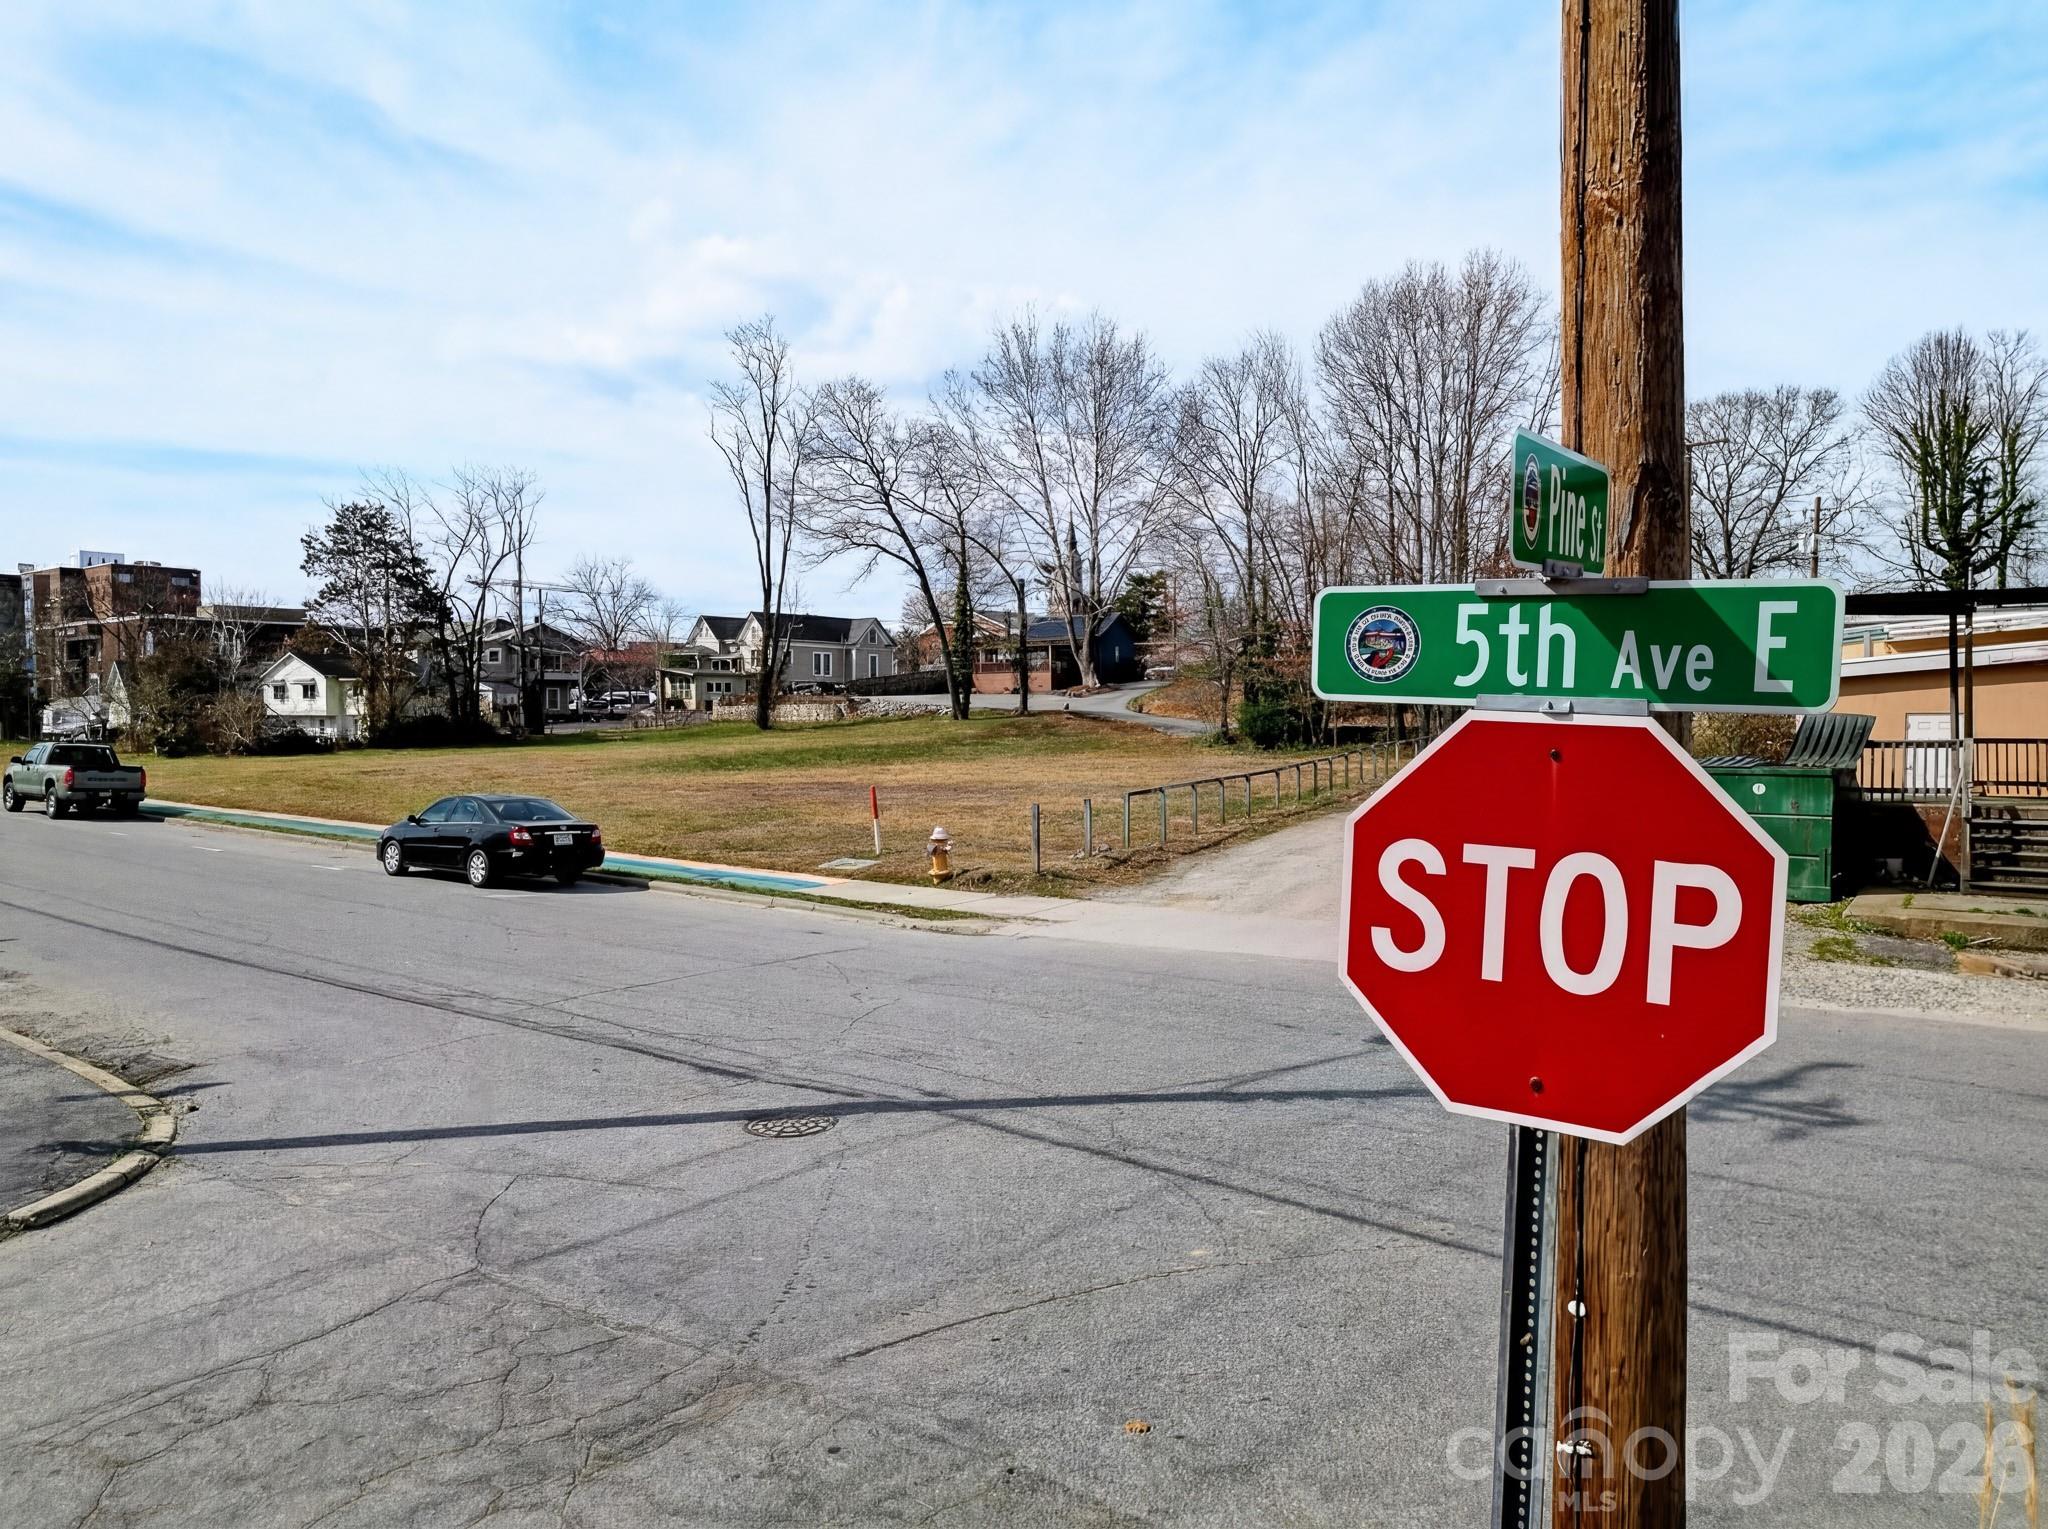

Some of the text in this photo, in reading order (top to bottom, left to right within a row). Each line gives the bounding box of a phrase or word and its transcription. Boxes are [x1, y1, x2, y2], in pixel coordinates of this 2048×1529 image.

[1548, 463, 1603, 562] Pine St
[1453, 602, 1577, 689] 5th
[1610, 630, 1714, 691] Ave
[1753, 600, 1799, 693] E
[1370, 838, 1743, 1006] STOP
